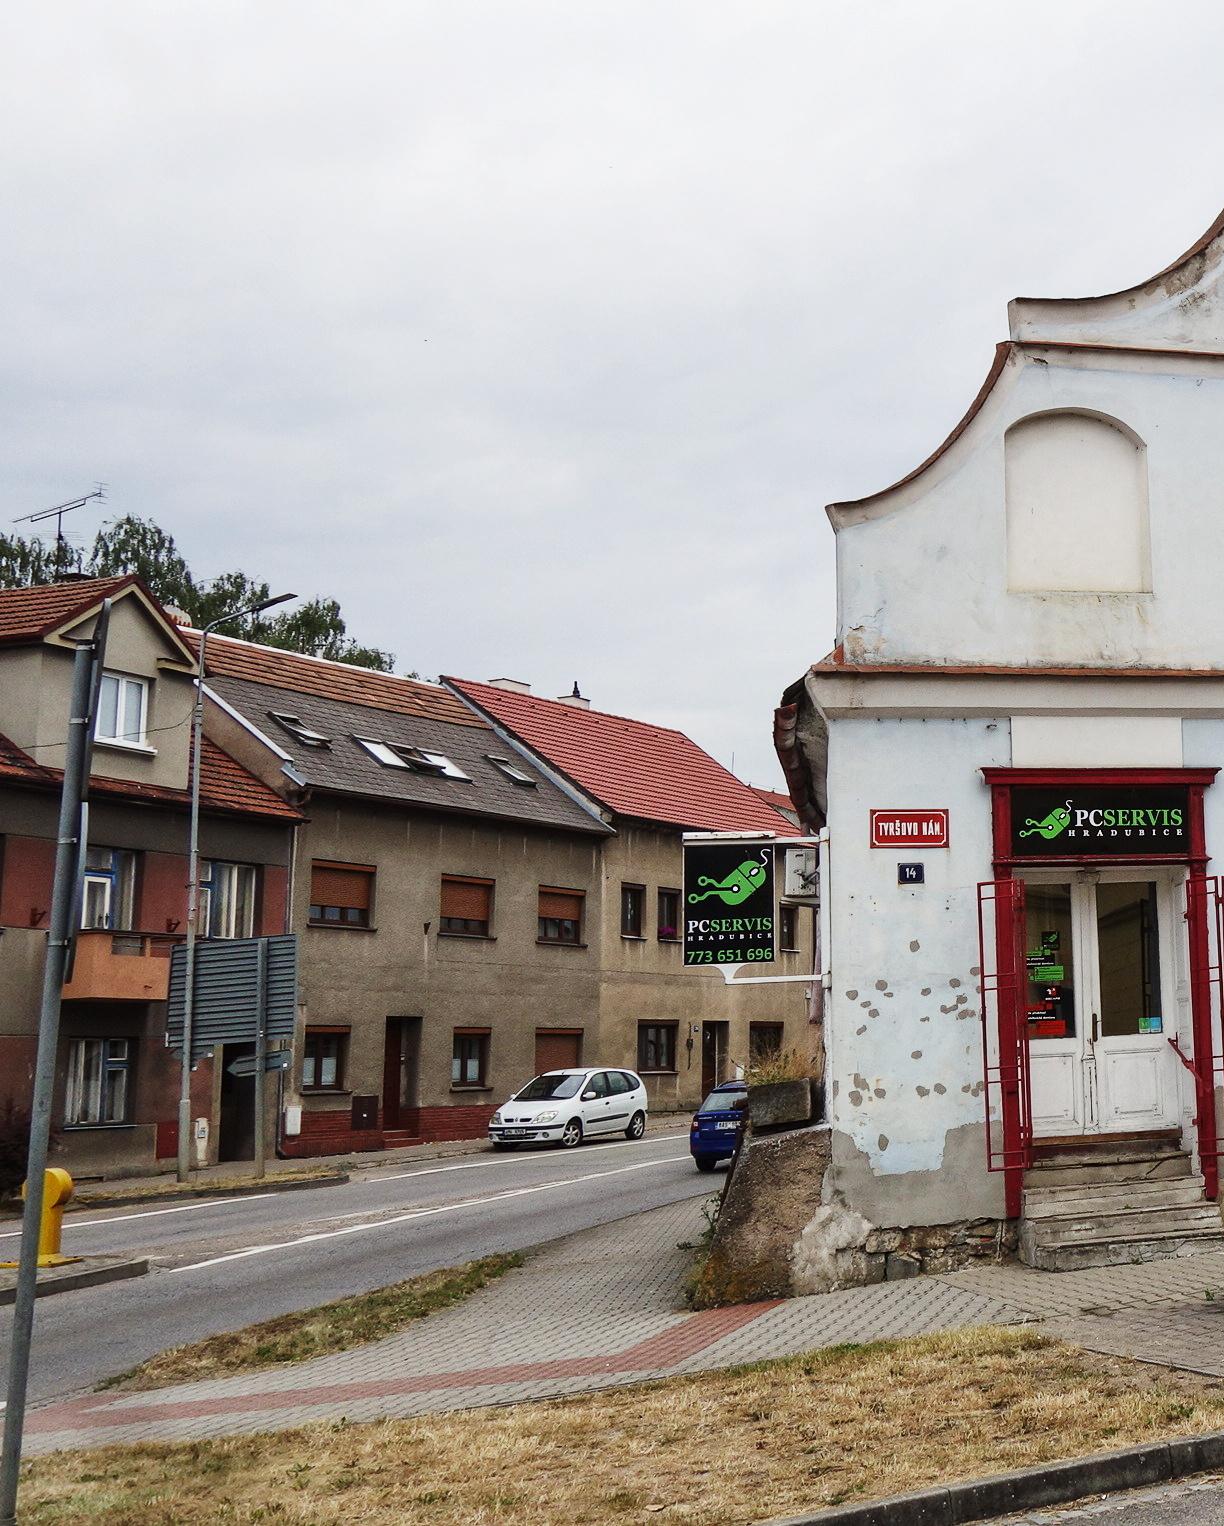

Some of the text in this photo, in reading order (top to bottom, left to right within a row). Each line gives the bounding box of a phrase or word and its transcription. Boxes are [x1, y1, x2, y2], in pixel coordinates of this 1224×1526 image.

[1074, 809, 1183, 827] PCSERVIS
[878, 819, 943, 836] TYRŠOVO NÁM.
[1068, 829, 1183, 837] HRADUBICE
[905, 867, 917, 879] 14
[687, 917, 772, 934] PCSERVIS
[687, 933, 772, 942] HRADUBICE
[687, 948, 772, 963] 773 651 696
